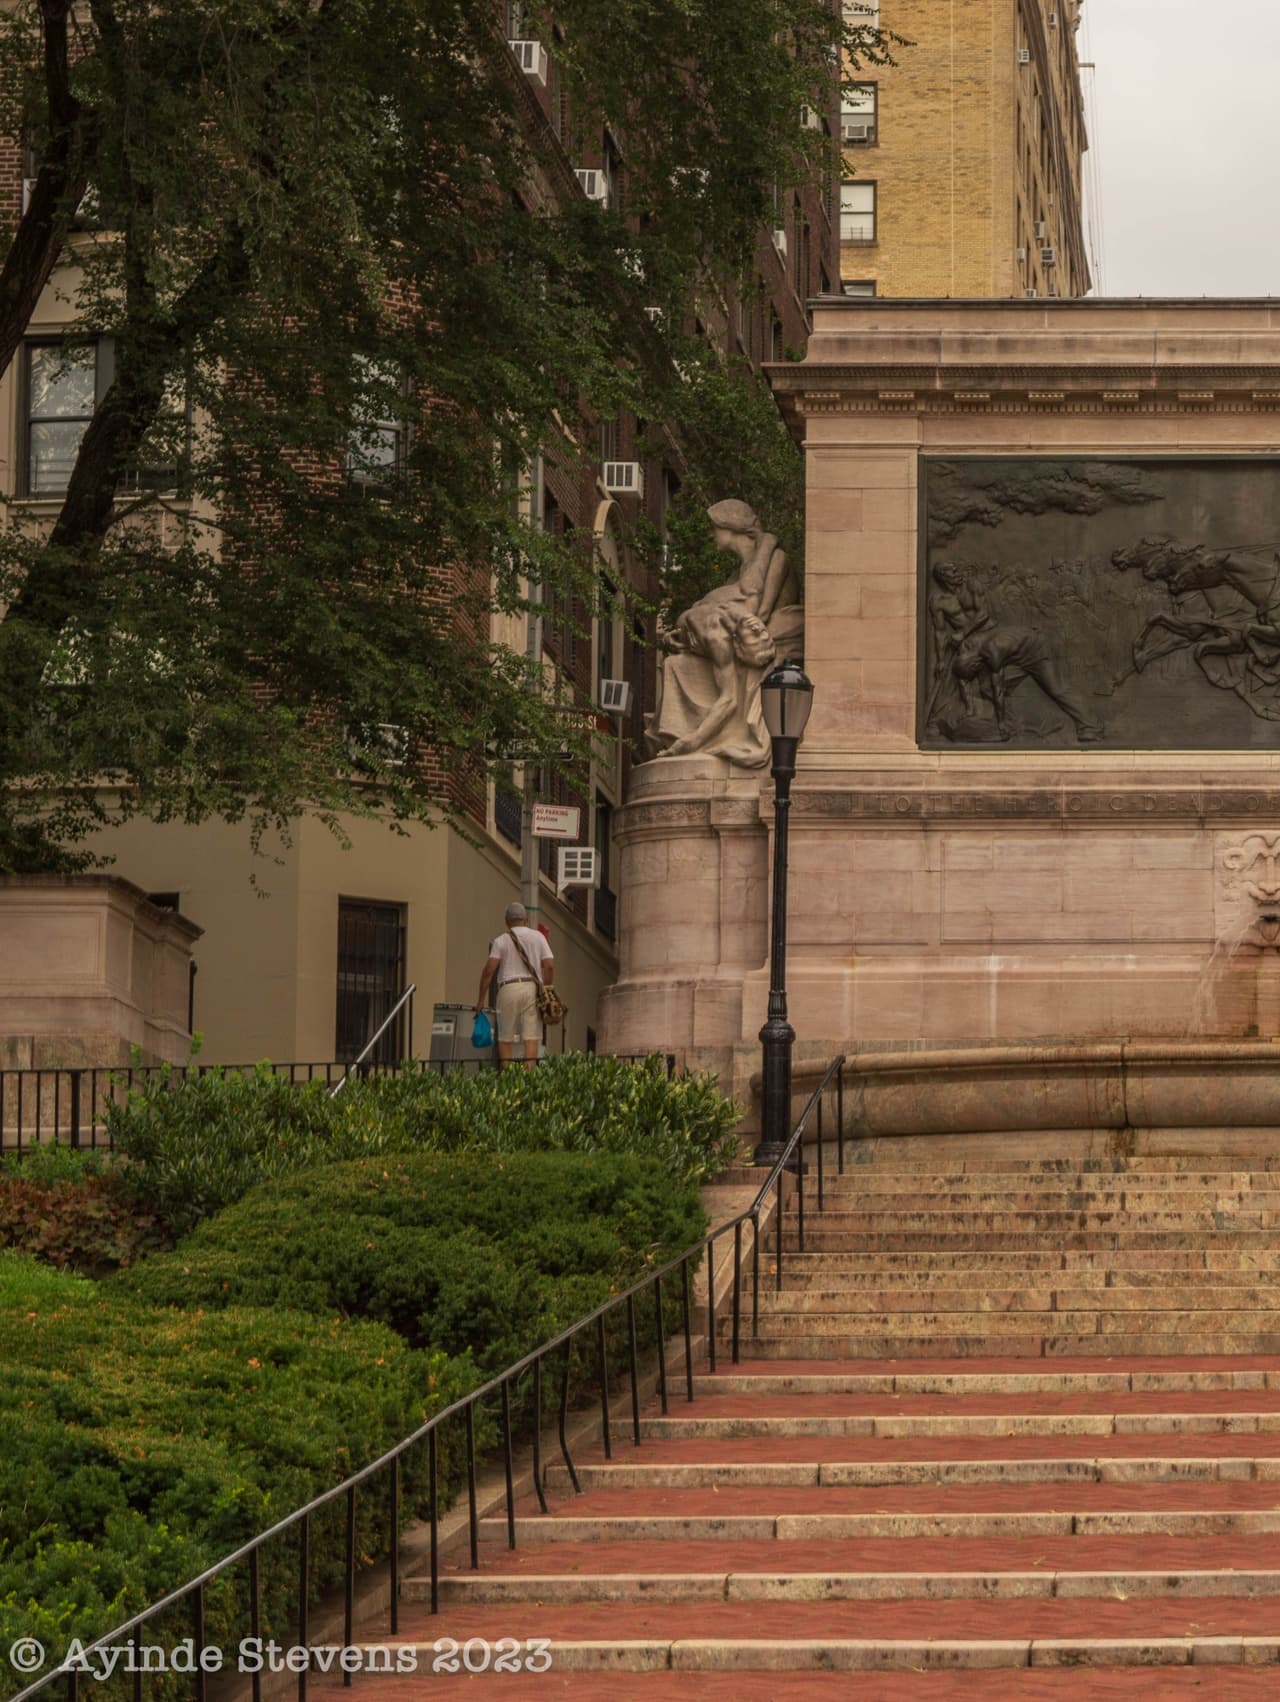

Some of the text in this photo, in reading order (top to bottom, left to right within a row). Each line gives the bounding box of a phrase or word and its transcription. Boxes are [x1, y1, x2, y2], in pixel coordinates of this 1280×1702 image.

[877, 795, 911, 812] TO
[930, 795, 984, 812] THE
[1246, 795, 1280, 811] OF
